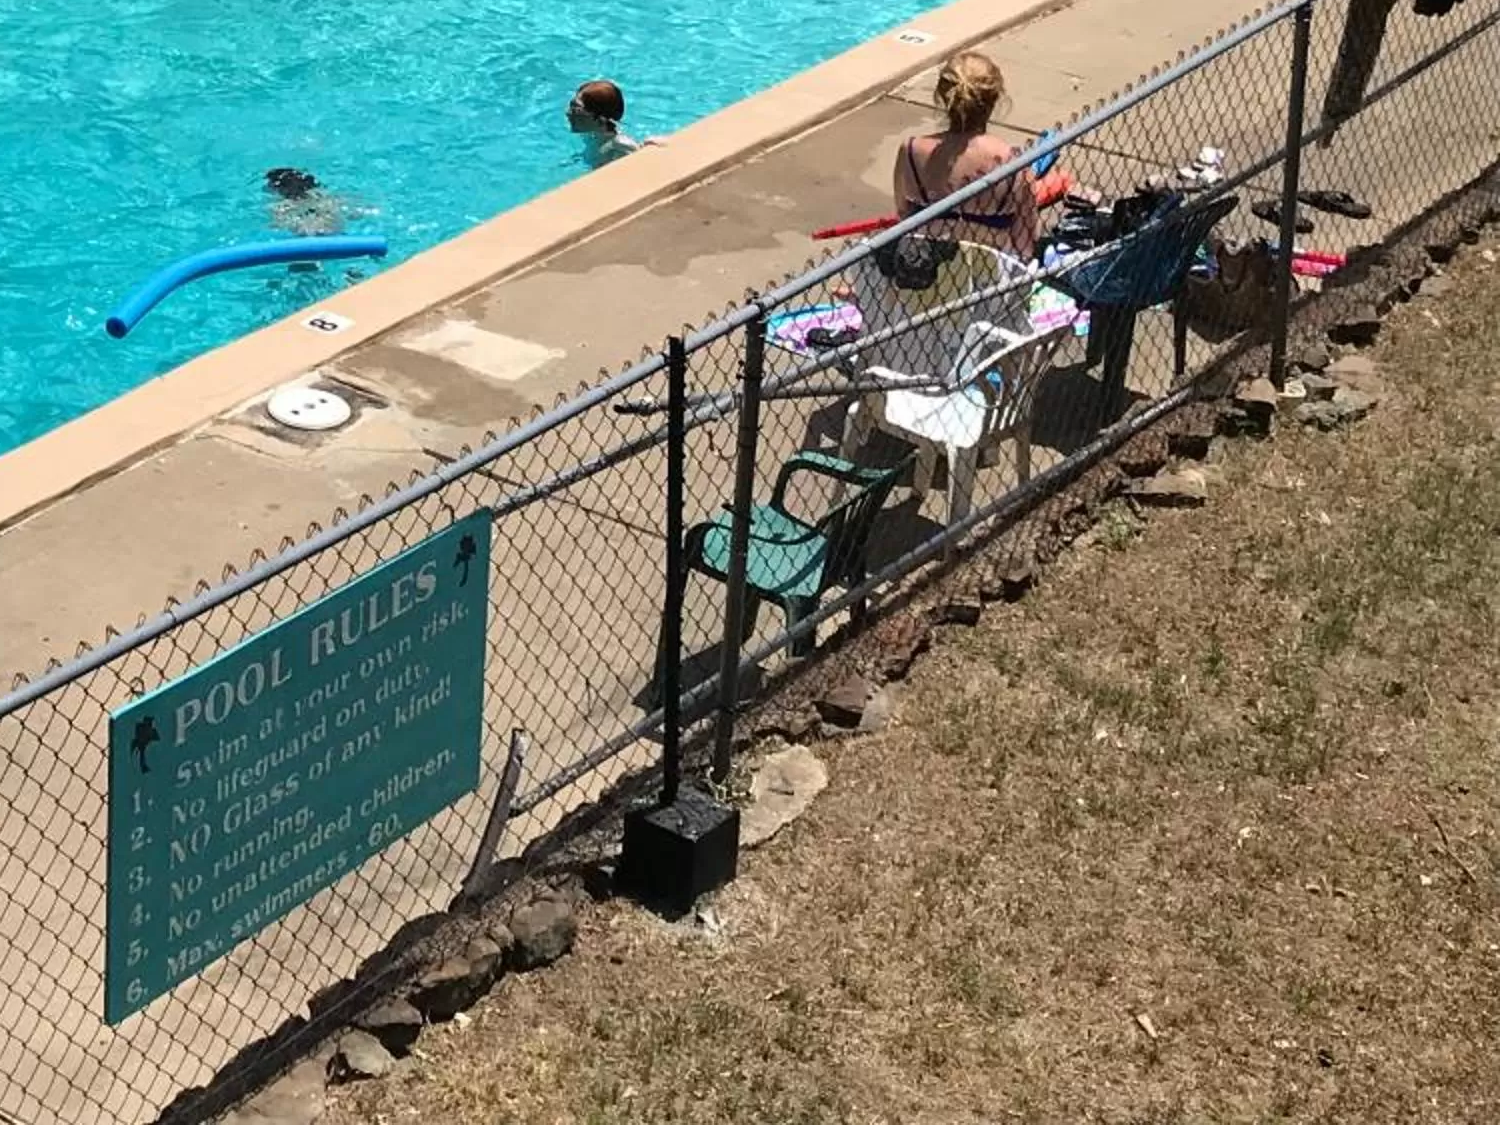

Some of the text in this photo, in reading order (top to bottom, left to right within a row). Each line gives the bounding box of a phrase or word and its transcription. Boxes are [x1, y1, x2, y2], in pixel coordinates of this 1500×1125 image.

[309, 318, 338, 332] 8
[132, 600, 469, 814] 1. Swim at your own risk.
[175, 560, 437, 746] POOL RULES
[128, 673, 451, 894] 3. NO Glass of any kind!
[131, 664, 430, 852] 2. No lifeguard on duty.
[126, 978, 149, 1004] 6.
[166, 932, 223, 983] Max.
[230, 850, 349, 939] swimmers
[127, 748, 456, 967] 5. No unattended children.
[130, 806, 315, 926] 4. No running.
